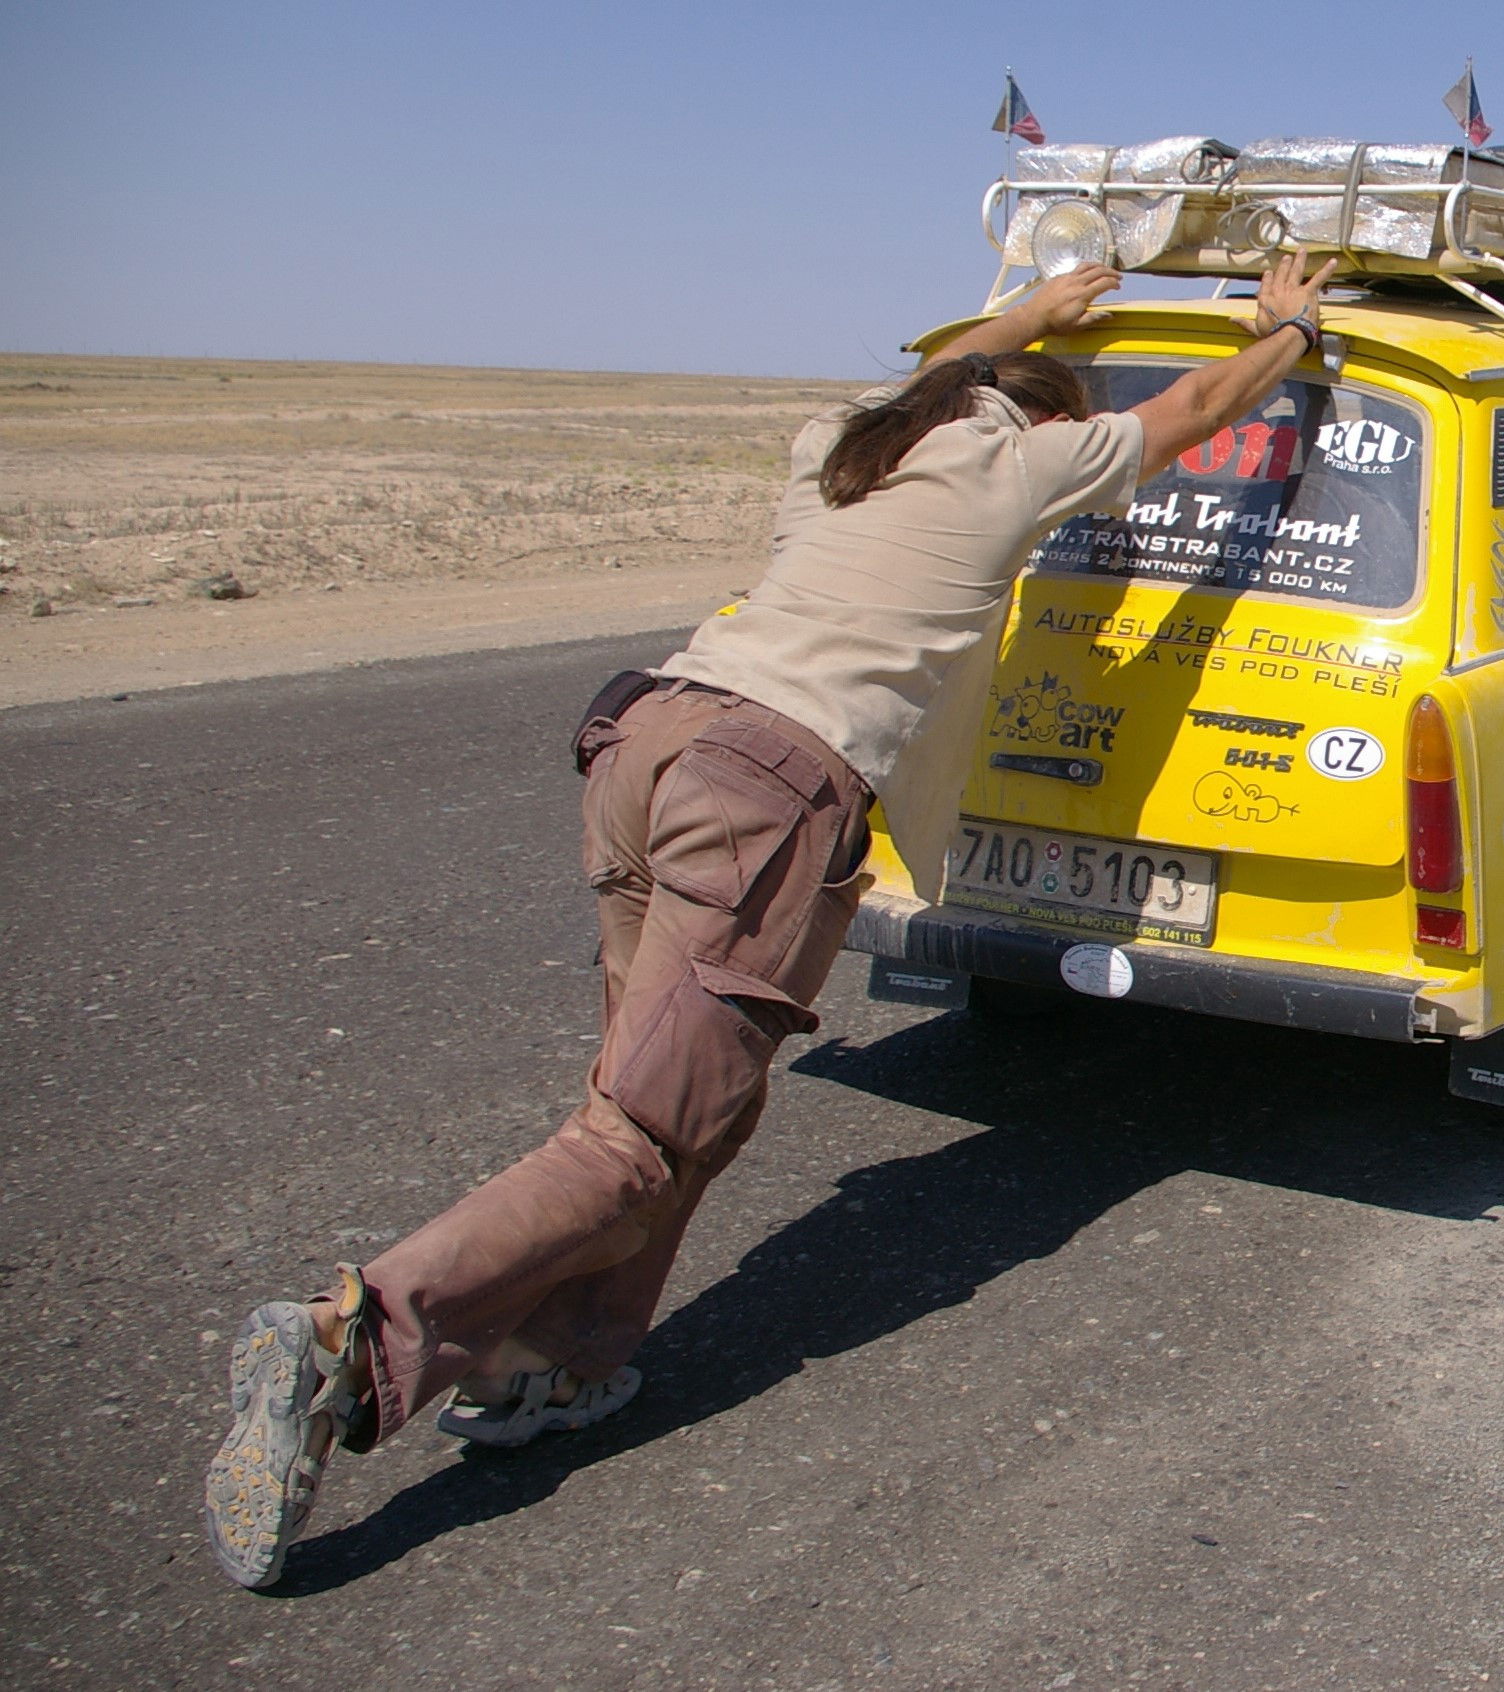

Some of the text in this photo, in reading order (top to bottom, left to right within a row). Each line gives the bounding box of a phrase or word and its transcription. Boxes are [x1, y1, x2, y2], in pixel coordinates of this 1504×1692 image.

[1314, 419, 1416, 464] EGU
[1323, 453, 1393, 474] Praha s.r.o.
[1194, 494, 1361, 547] Trabant
[1098, 553, 1110, 565] 2
[1237, 567, 1261, 582] 15
[1268, 571, 1313, 588] 000
[1321, 580, 1348, 594] KM
[1088, 643, 1402, 699] NOVÁ VES POD PLEŠÍ
[1059, 720, 1114, 752] art
[1323, 736, 1367, 773] CZ
[1069, 845, 1186, 912] 5103
[1162, 929, 1181, 940] 141
[1184, 932, 1202, 943] 115
